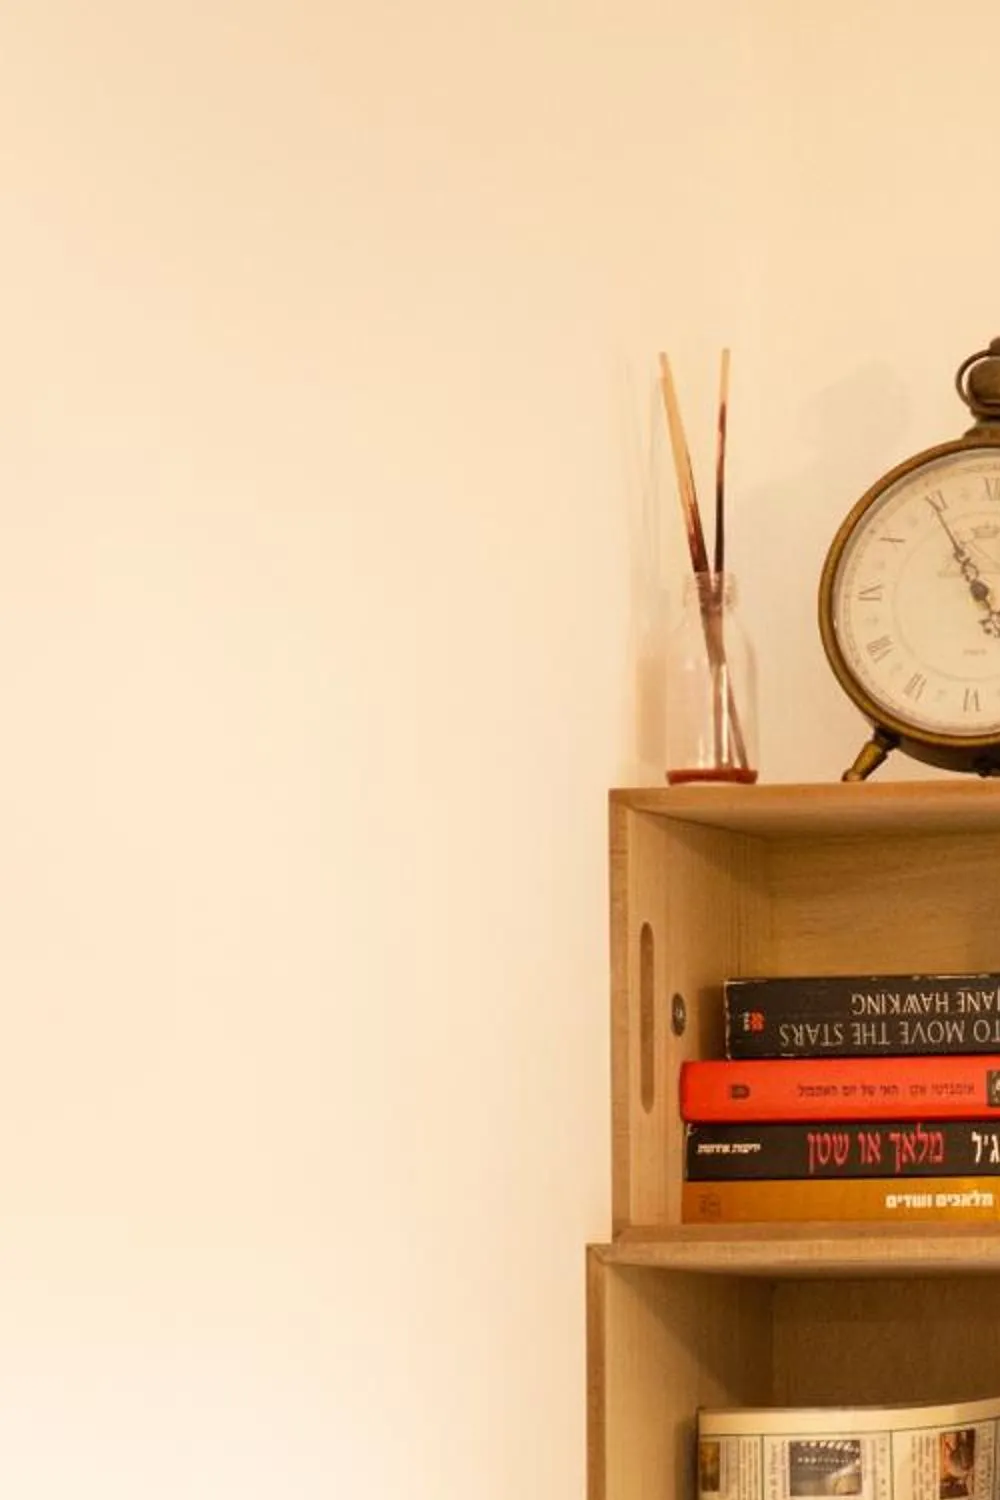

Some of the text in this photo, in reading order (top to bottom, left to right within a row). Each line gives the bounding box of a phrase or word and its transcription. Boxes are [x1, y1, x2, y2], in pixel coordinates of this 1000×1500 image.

[850, 988, 950, 1014] HAWKING
[778, 1021, 844, 1047] STARS
[851, 1022, 889, 1045] THE
[899, 1020, 965, 1044] MOVE
[806, 1123, 945, 1174] מלאך או שטן
[885, 1189, 994, 1209] מלאכים ושדים
